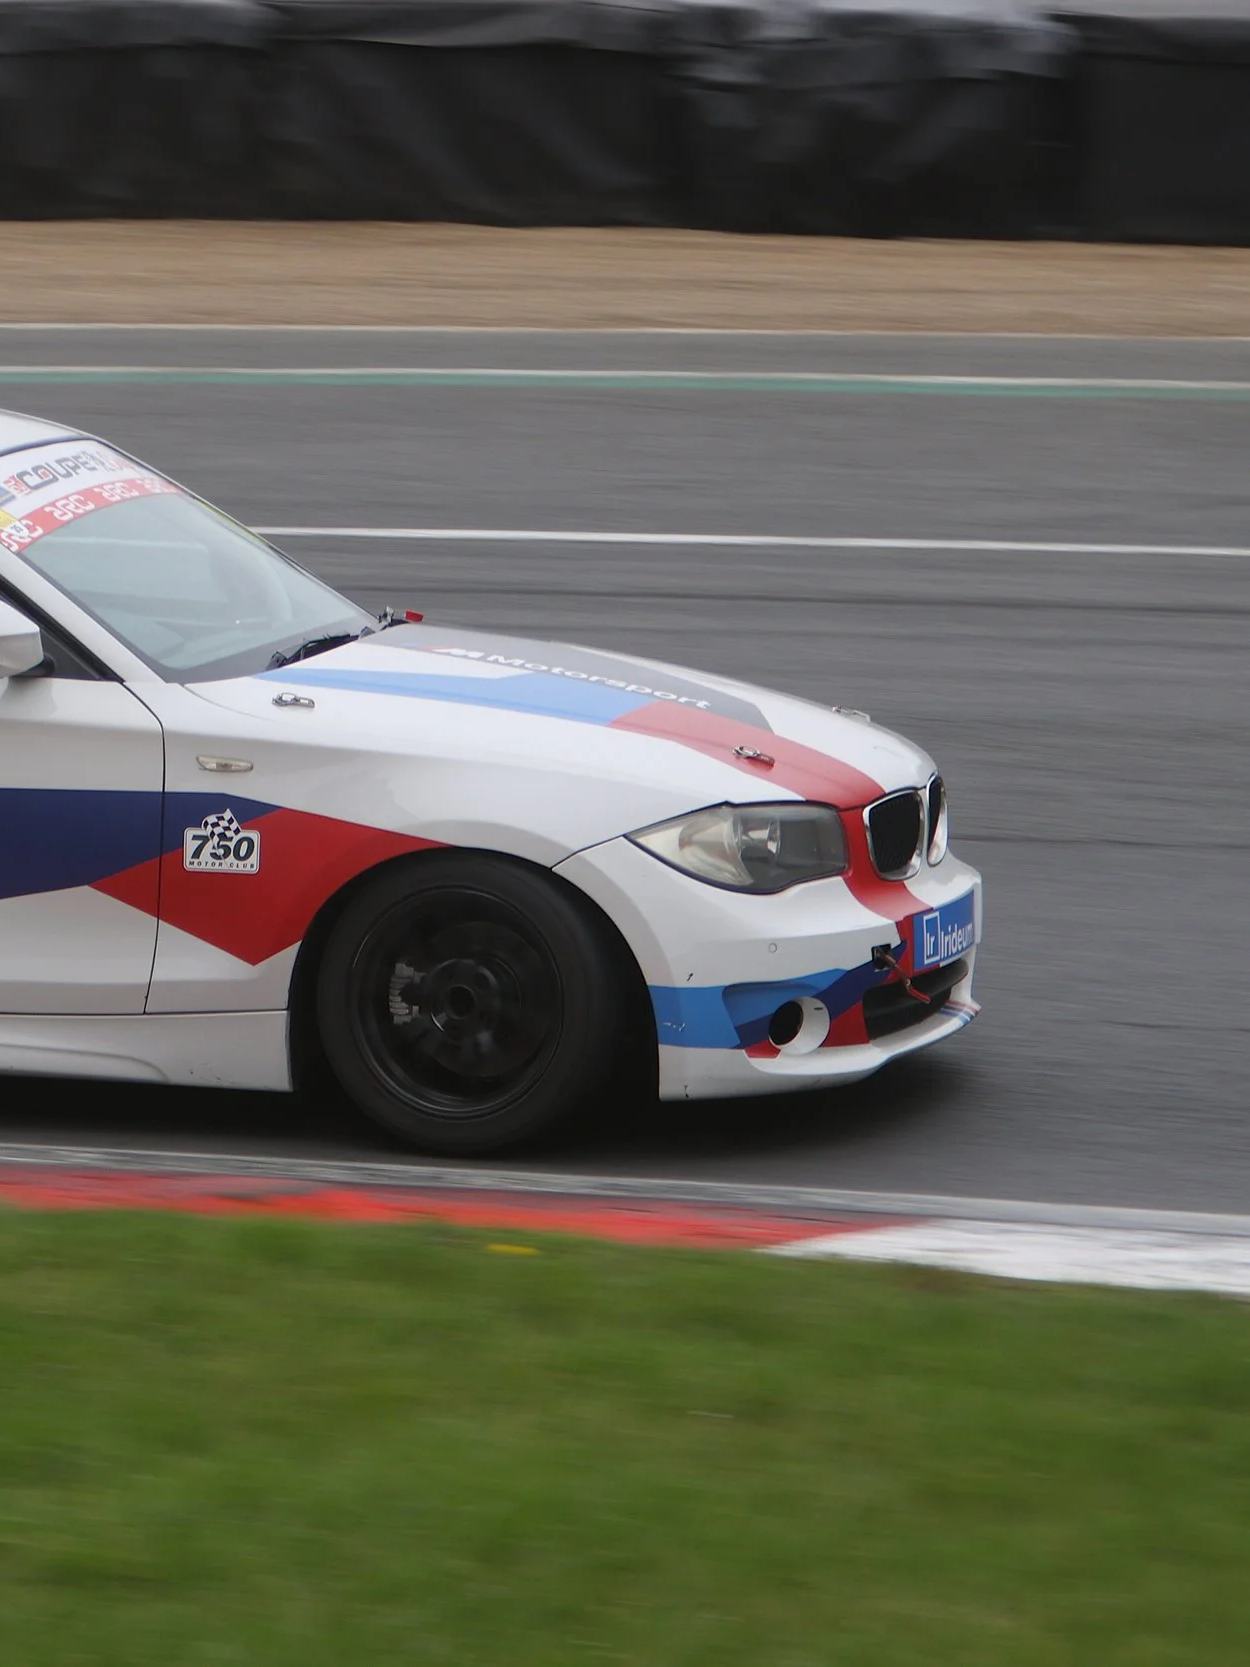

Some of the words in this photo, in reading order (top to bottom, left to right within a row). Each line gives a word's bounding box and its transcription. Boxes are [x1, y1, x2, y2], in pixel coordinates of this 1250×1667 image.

[487, 654, 711, 709] Motorsport
[190, 833, 255, 862] 750
[188, 860, 223, 868] MOTOR
[229, 861, 255, 869] CLUB
